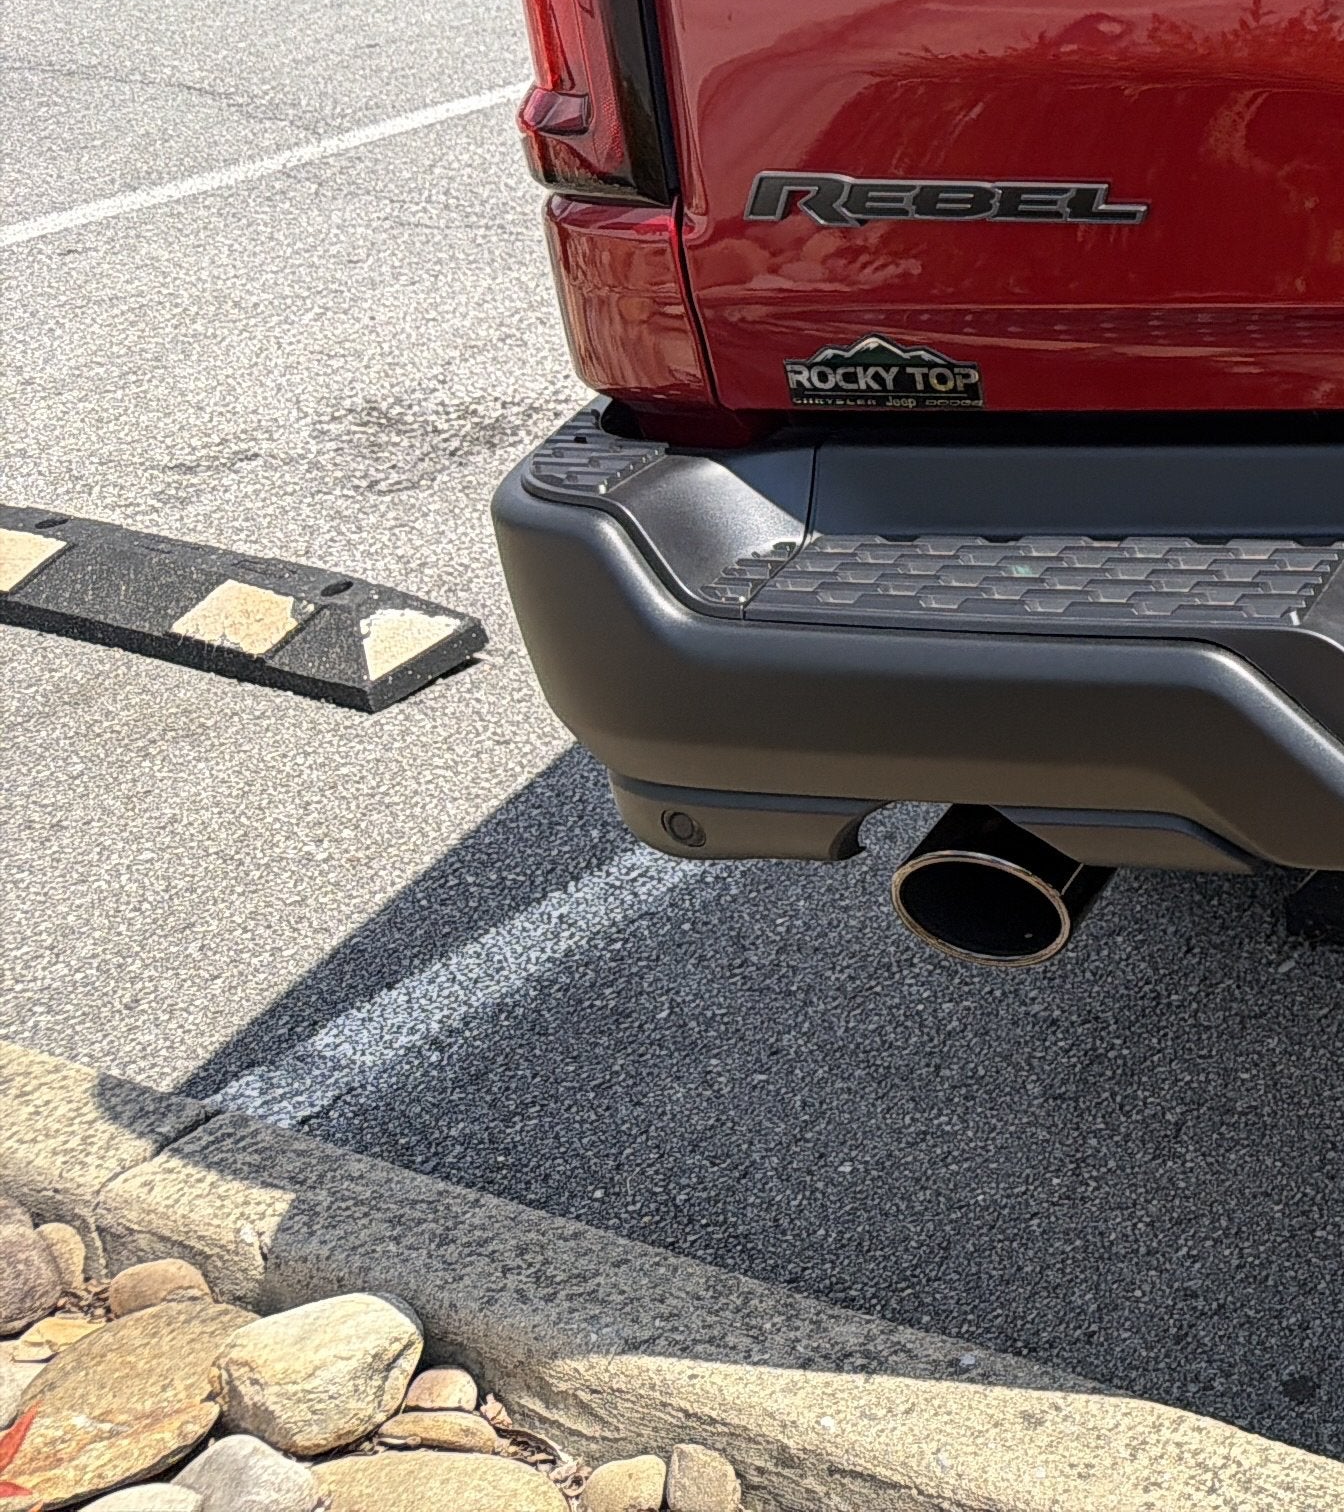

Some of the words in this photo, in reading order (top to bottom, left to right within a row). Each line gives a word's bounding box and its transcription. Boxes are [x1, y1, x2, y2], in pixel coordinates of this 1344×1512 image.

[744, 170, 1148, 228] REBEL
[786, 364, 899, 390] ROCKY
[906, 367, 979, 392] TOP
[886, 396, 916, 409] Jeep
